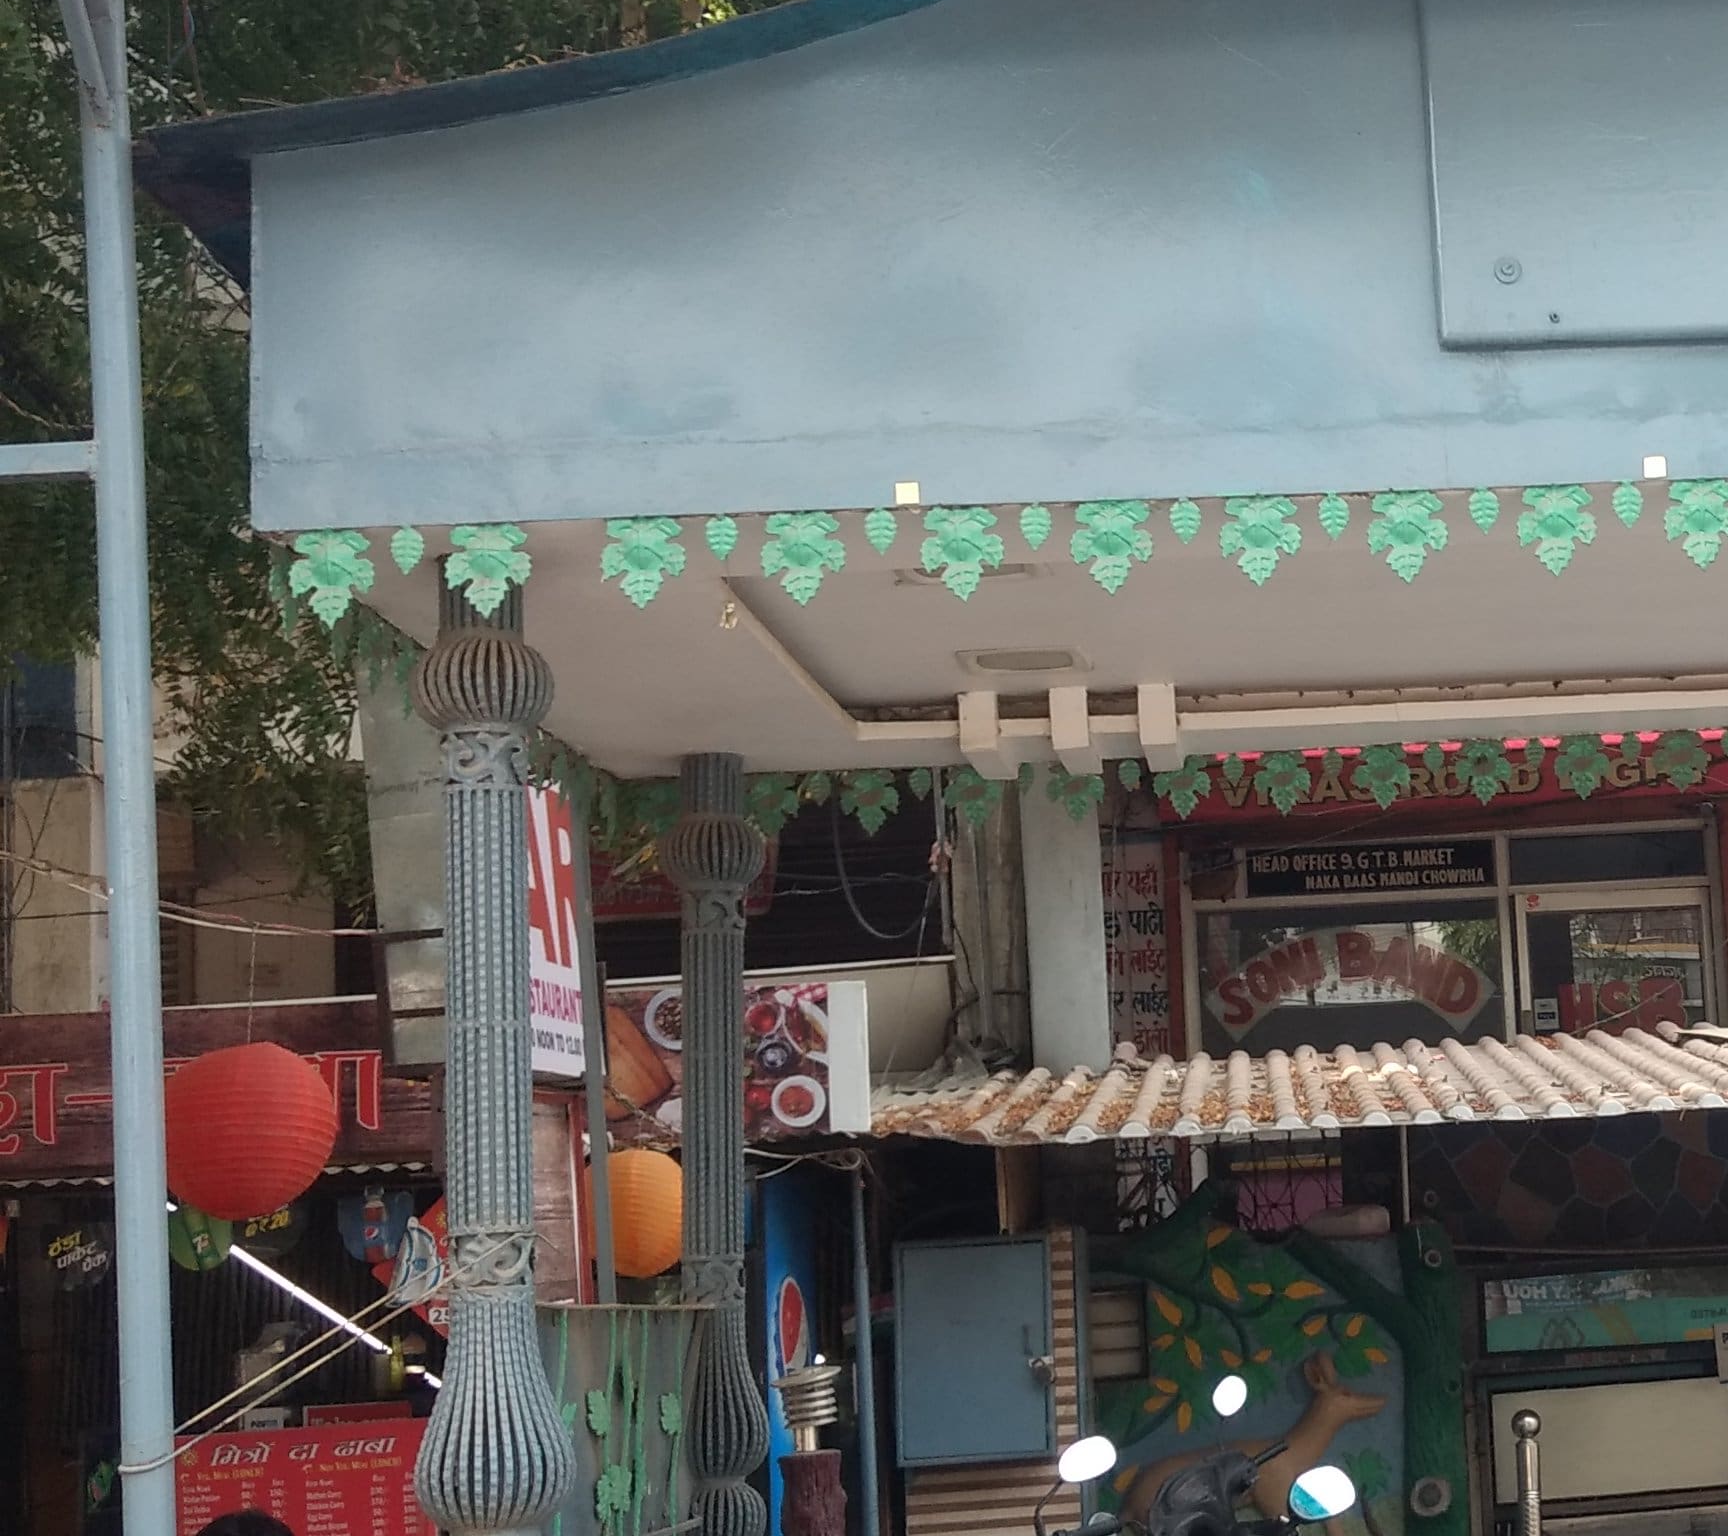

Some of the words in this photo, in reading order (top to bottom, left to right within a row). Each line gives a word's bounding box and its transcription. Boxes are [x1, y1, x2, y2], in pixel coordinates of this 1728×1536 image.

[1252, 855, 1289, 874] HEAD
[1292, 853, 1338, 872] OFFICE
[1217, 936, 1326, 1026] SONI
[1334, 930, 1480, 1015] BAND
